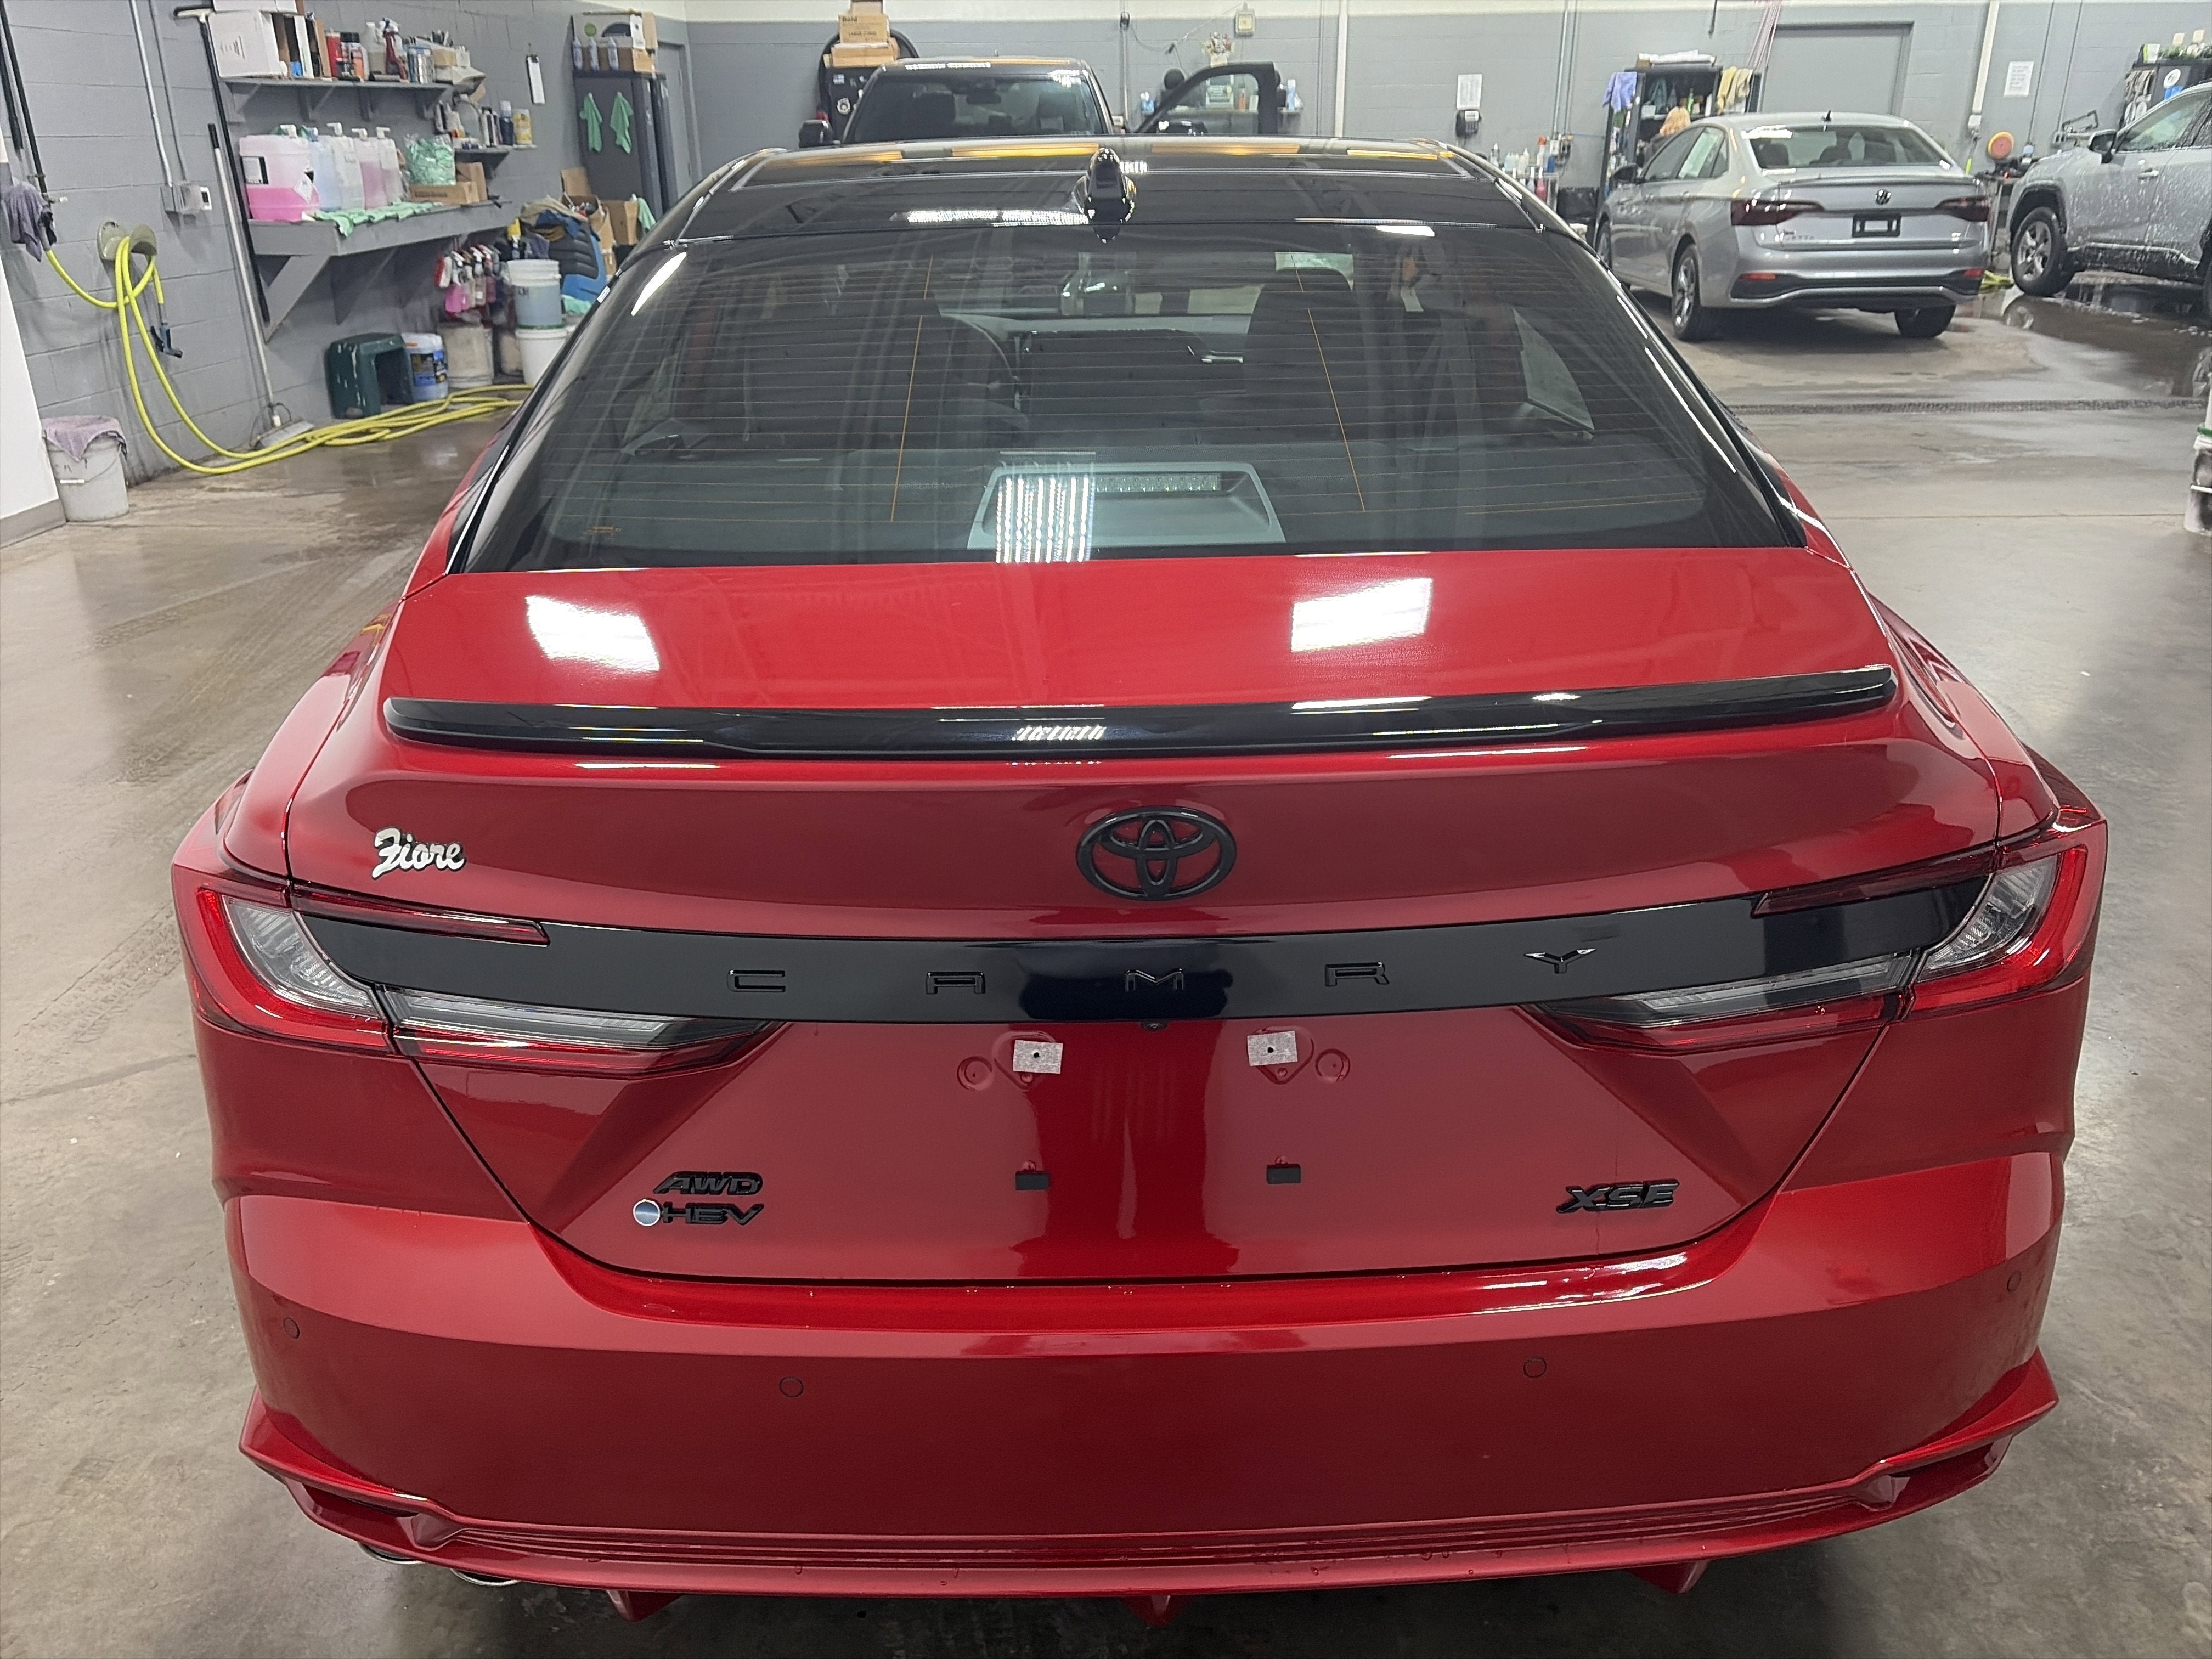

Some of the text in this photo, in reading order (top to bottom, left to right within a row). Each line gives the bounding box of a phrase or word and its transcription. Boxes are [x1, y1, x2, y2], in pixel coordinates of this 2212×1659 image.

[371, 826, 466, 879] Fiore
[727, 947, 1597, 995] CAMRY
[653, 1171, 763, 1195] AWD
[1556, 1178, 1680, 1213] XSE
[662, 1201, 764, 1226] HEV
